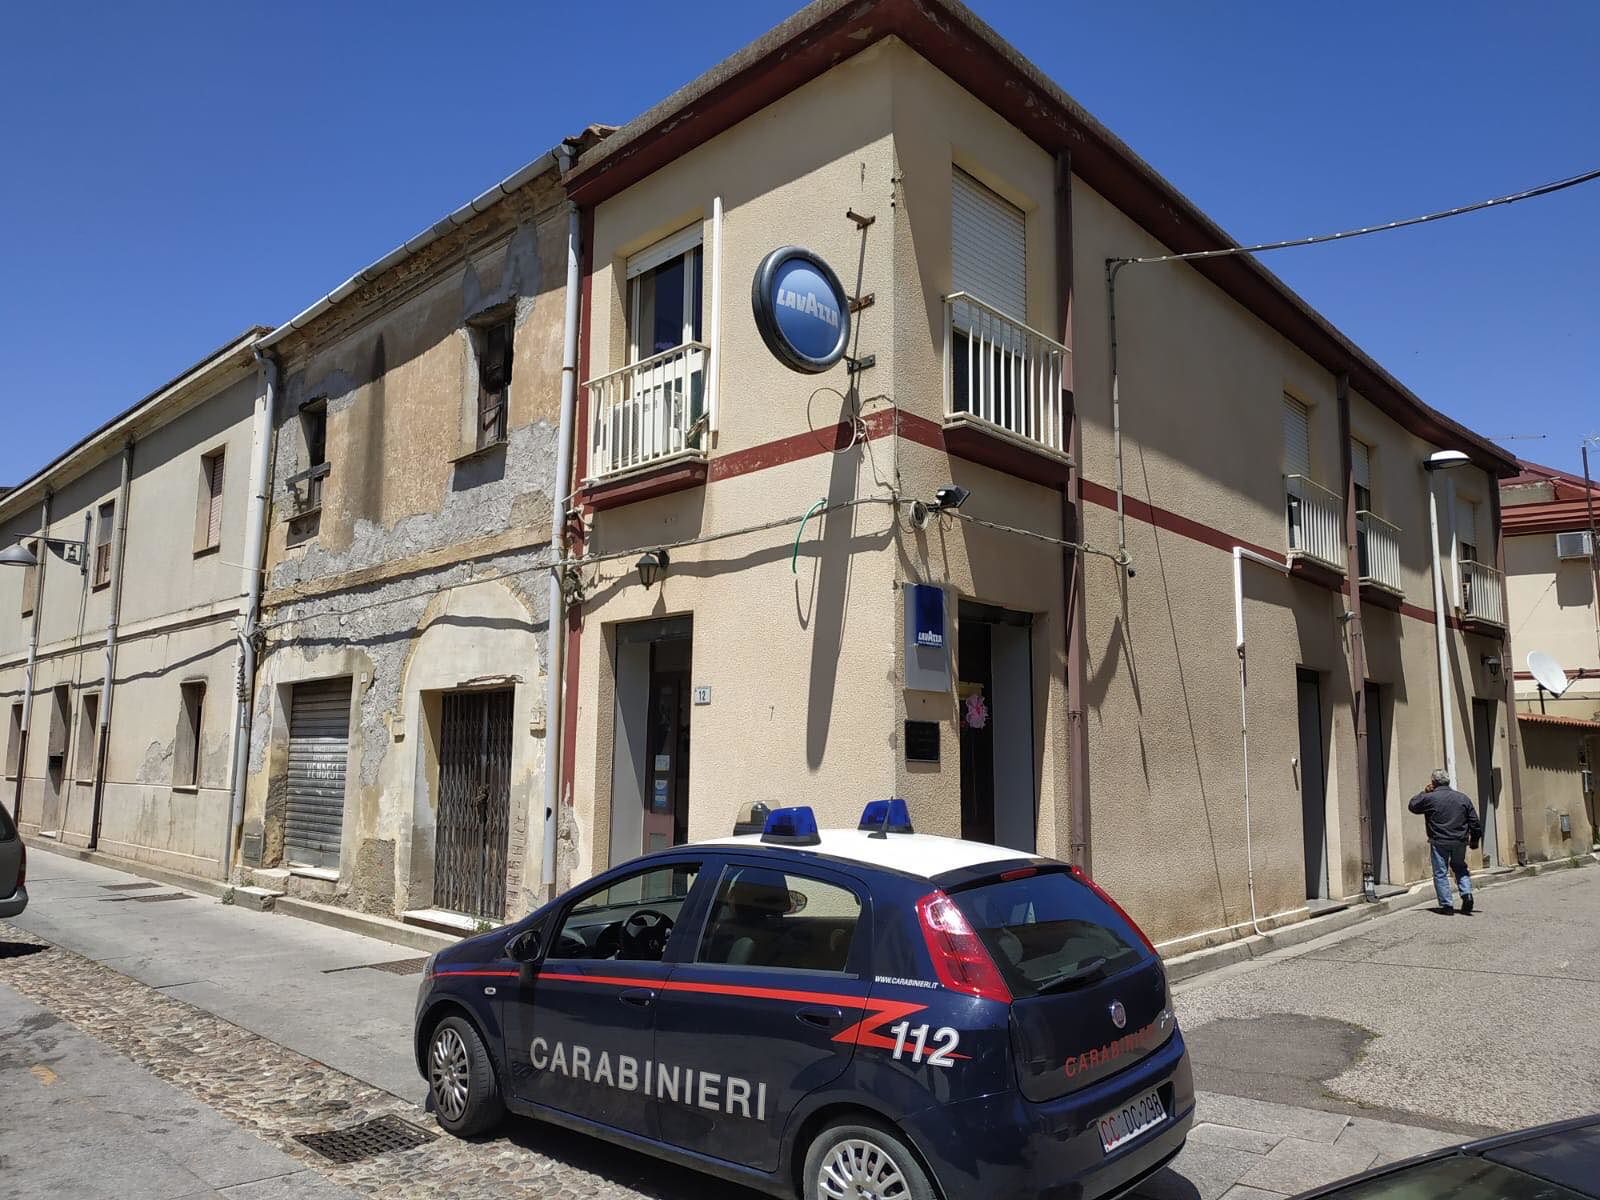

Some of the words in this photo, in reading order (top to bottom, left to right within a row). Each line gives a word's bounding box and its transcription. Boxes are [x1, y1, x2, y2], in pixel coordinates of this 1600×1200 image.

[776, 287, 839, 329] LAVAZZA
[698, 690, 706, 701] 12
[875, 975, 939, 989] WWW.CARABINIERI.IT
[891, 1021, 960, 1068] 112
[530, 1036, 767, 1121] CARABINIERI
